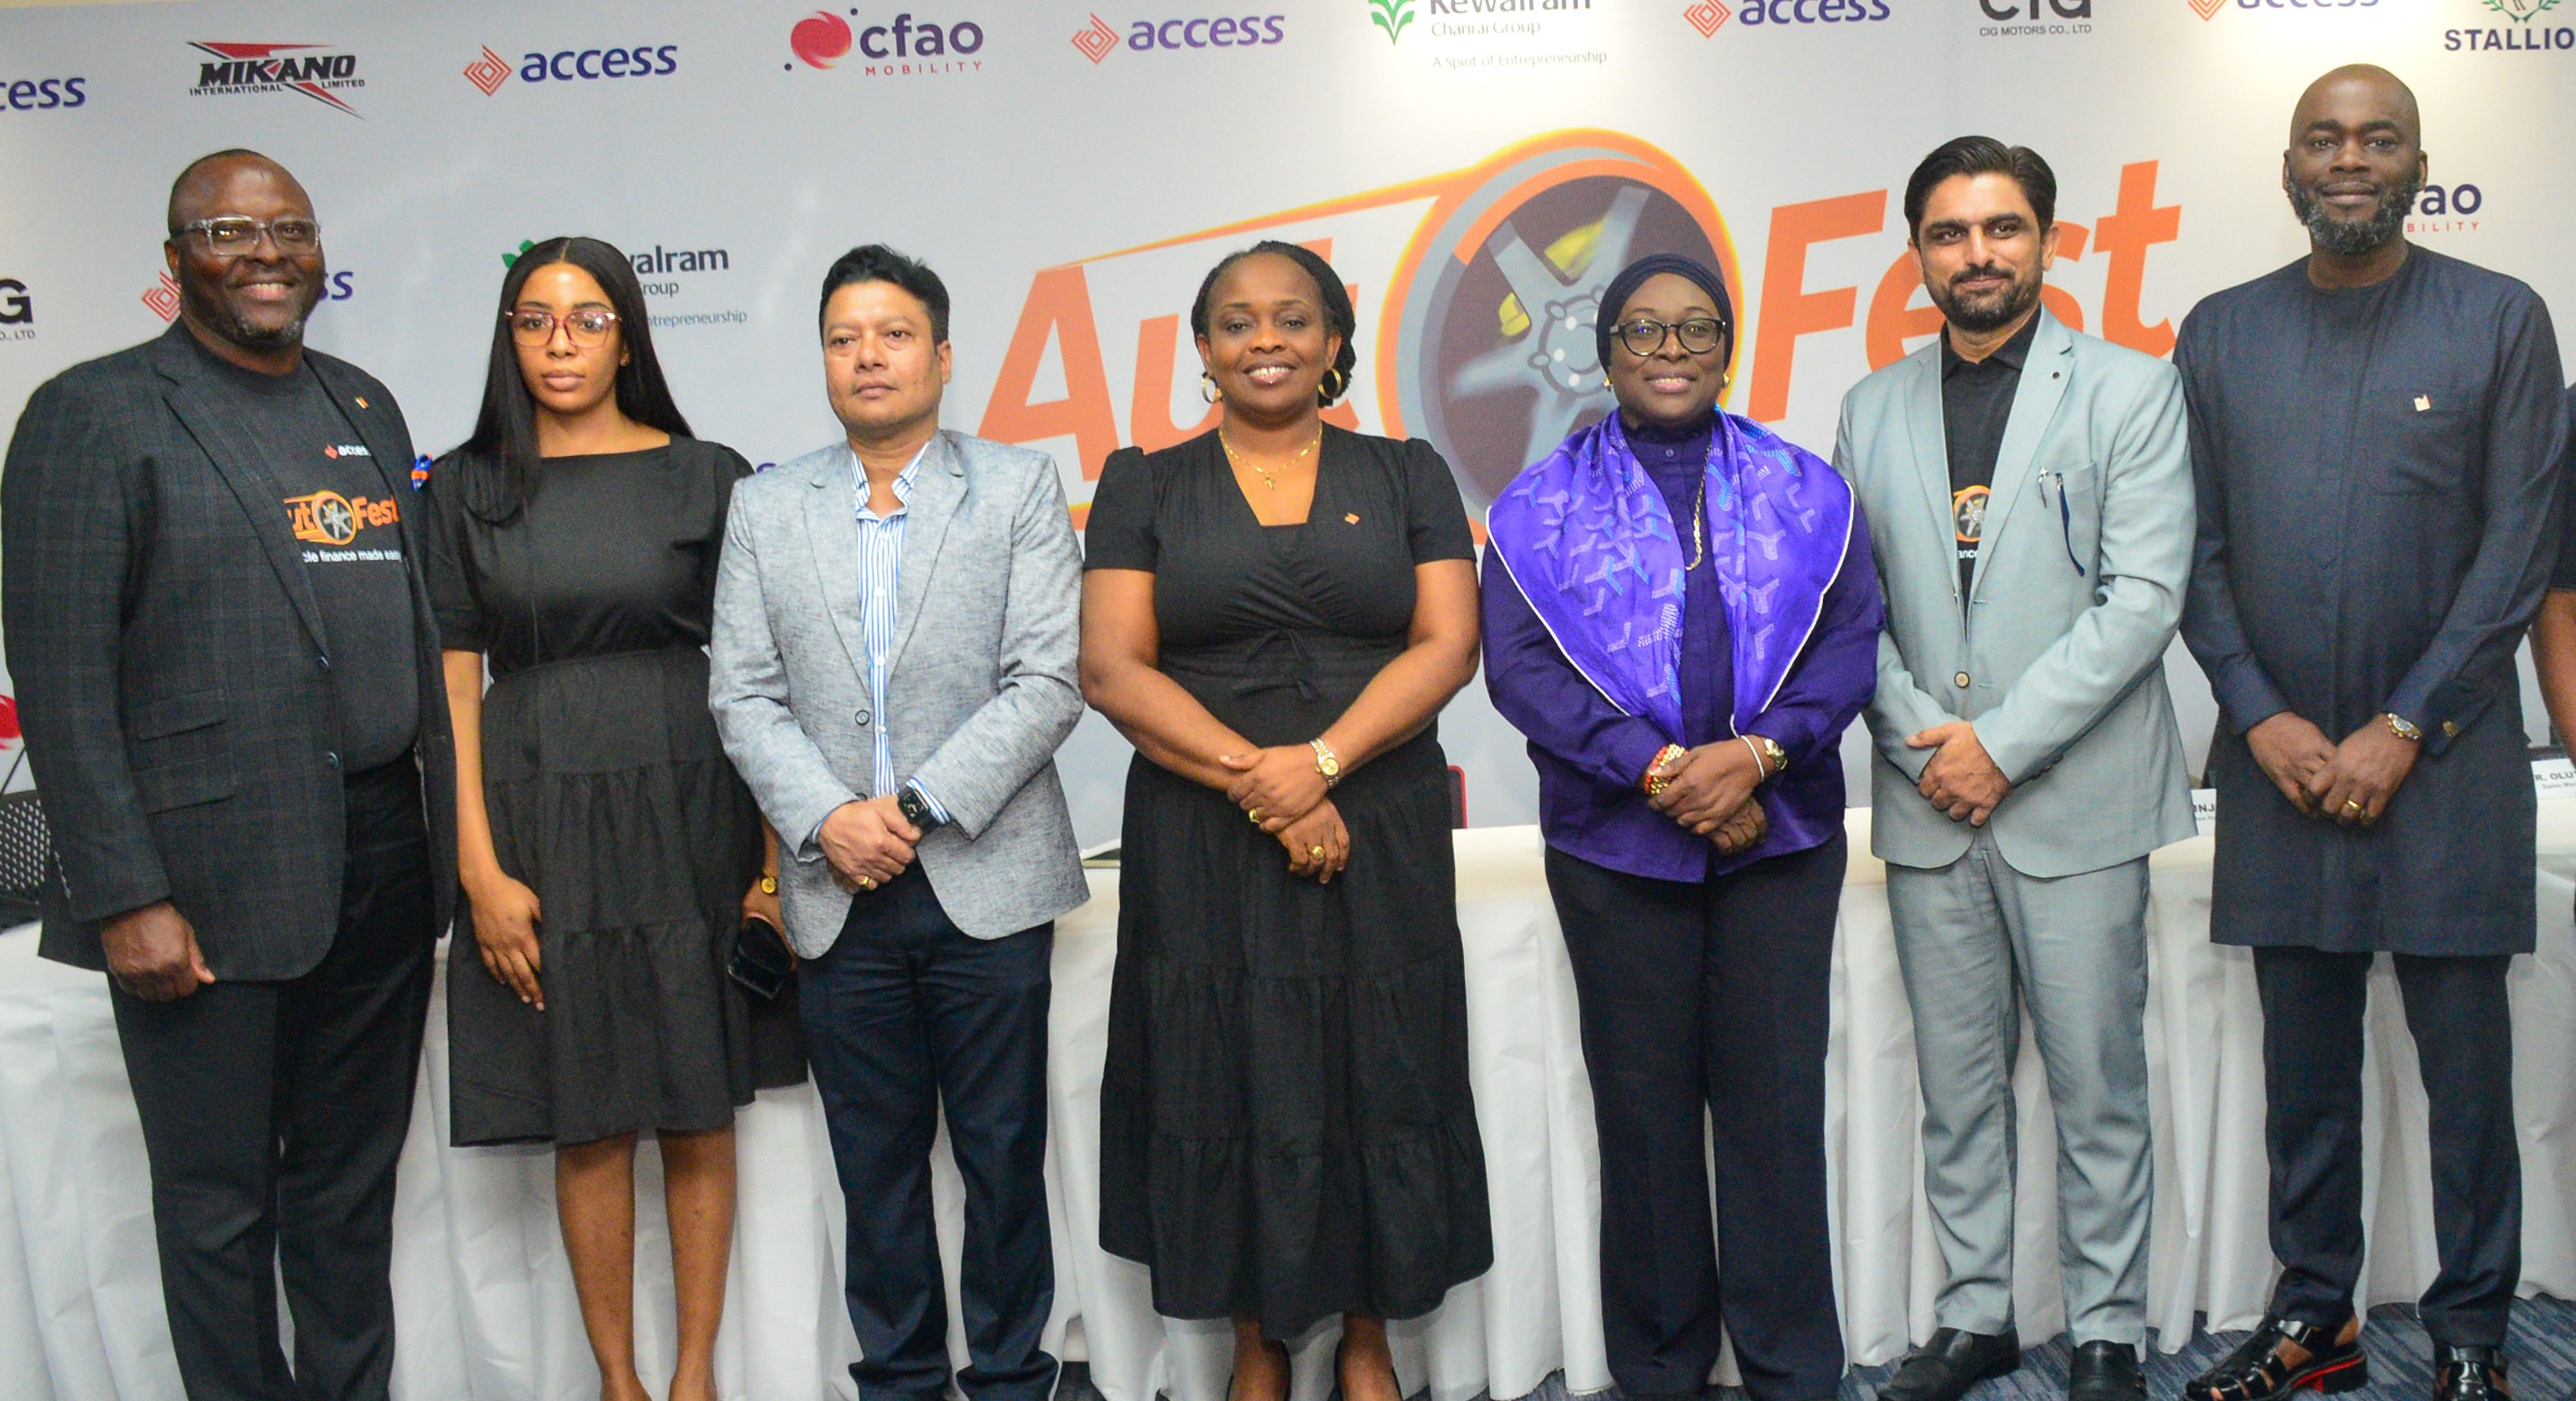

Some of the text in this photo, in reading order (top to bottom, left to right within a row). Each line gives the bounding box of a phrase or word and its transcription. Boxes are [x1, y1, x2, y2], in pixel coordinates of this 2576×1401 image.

[1739, 0, 1891, 26] access
[860, 13, 983, 59] cfao
[1128, 15, 1285, 52] access
[1492, 20, 1541, 36] Group
[1980, 27, 1998, 36] CIG
[2001, 25, 2046, 36] MOTORS
[2072, 24, 2092, 34] LTD
[520, 45, 677, 83] access
[1499, 50, 1608, 68] Entrepreneurship
[198, 54, 356, 87] MIKANO
[865, 61, 981, 76] MOBILITY
[0, 77, 86, 111] ess
[189, 79, 365, 96] INTERNATIONAL LIMITED
[2406, 221, 2479, 233] BILITY
[629, 245, 729, 274] alram
[639, 282, 679, 298] roup
[14, 330, 36, 340] LTD
[319, 548, 357, 562] finance
[357, 548, 385, 561] made
